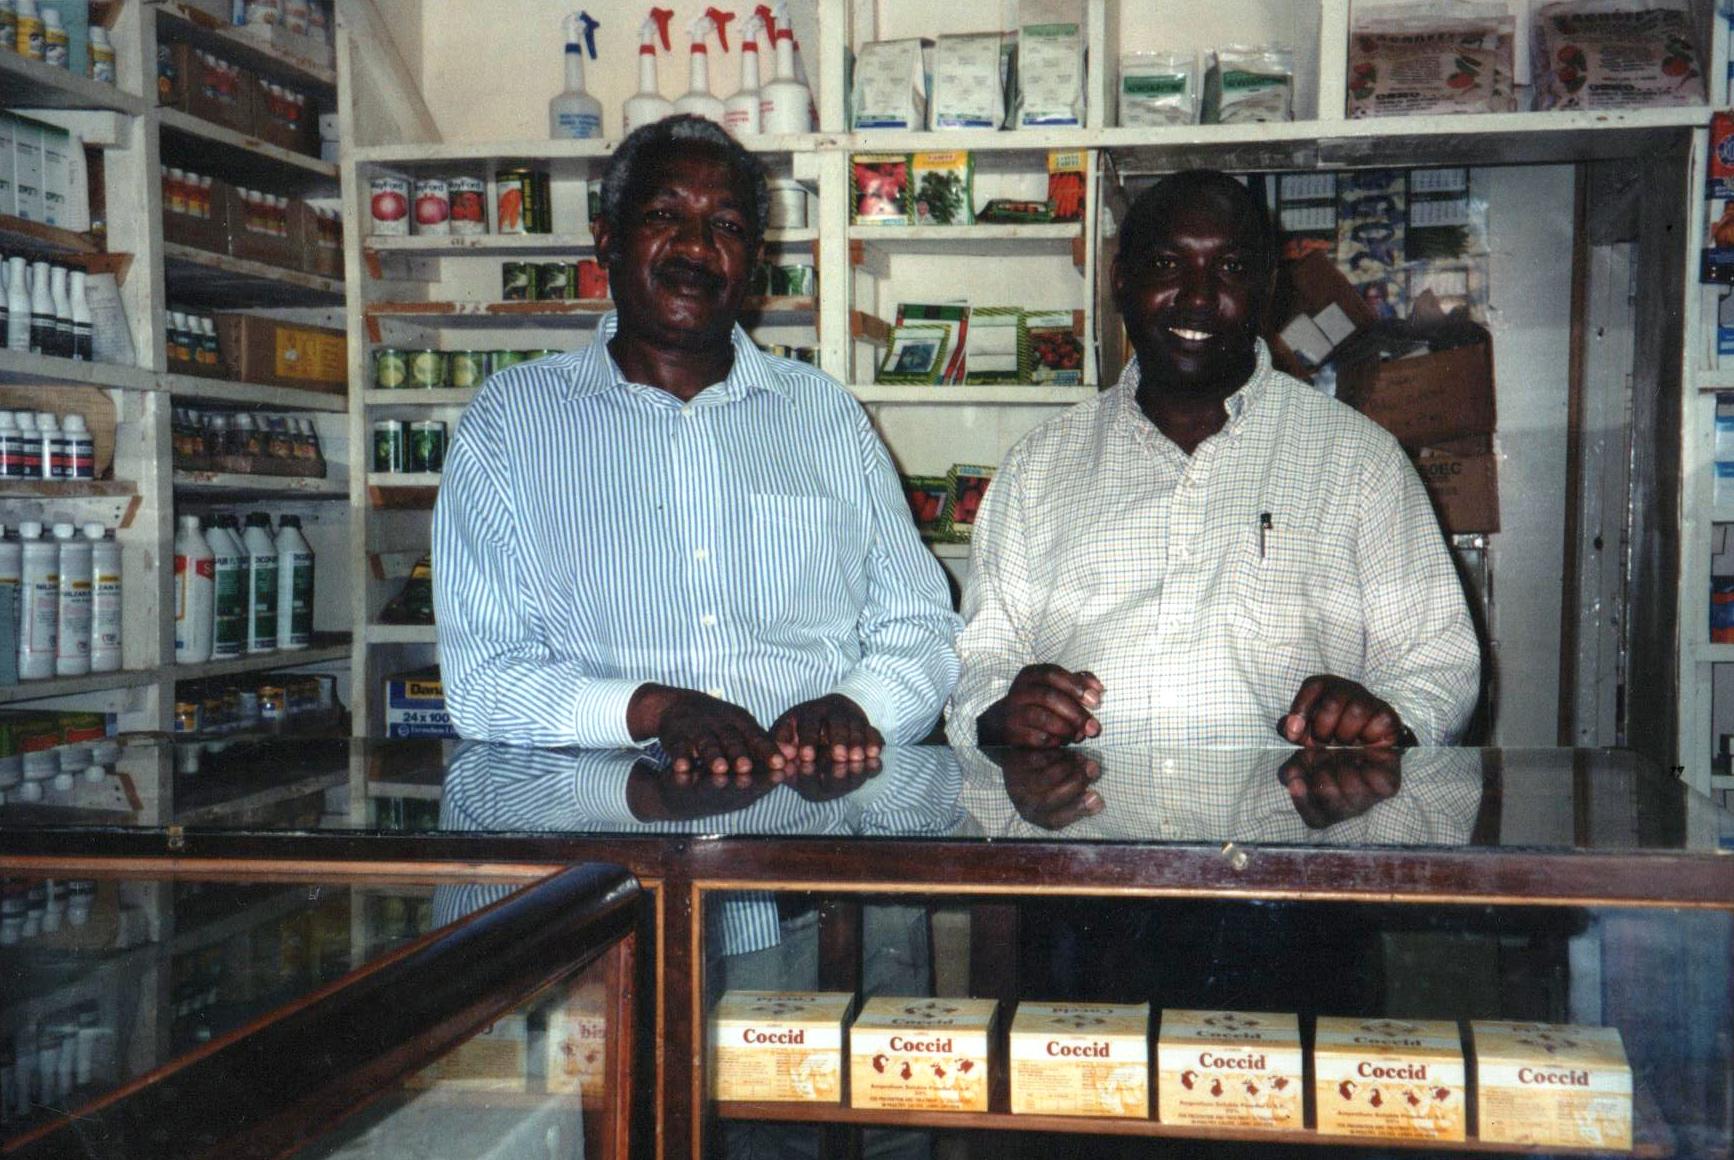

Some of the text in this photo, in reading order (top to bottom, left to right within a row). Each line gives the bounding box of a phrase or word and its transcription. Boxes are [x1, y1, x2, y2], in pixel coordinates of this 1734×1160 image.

[403, 711, 418, 722] 24
[420, 714, 427, 722] x
[743, 1028, 805, 1044] Coccid
[889, 1036, 953, 1053] Coccid
[1046, 1040, 1109, 1058] Coccid
[1199, 1052, 1266, 1070] Coccid
[1357, 1062, 1427, 1080] Coccid
[1518, 1067, 1590, 1086] Coccid
